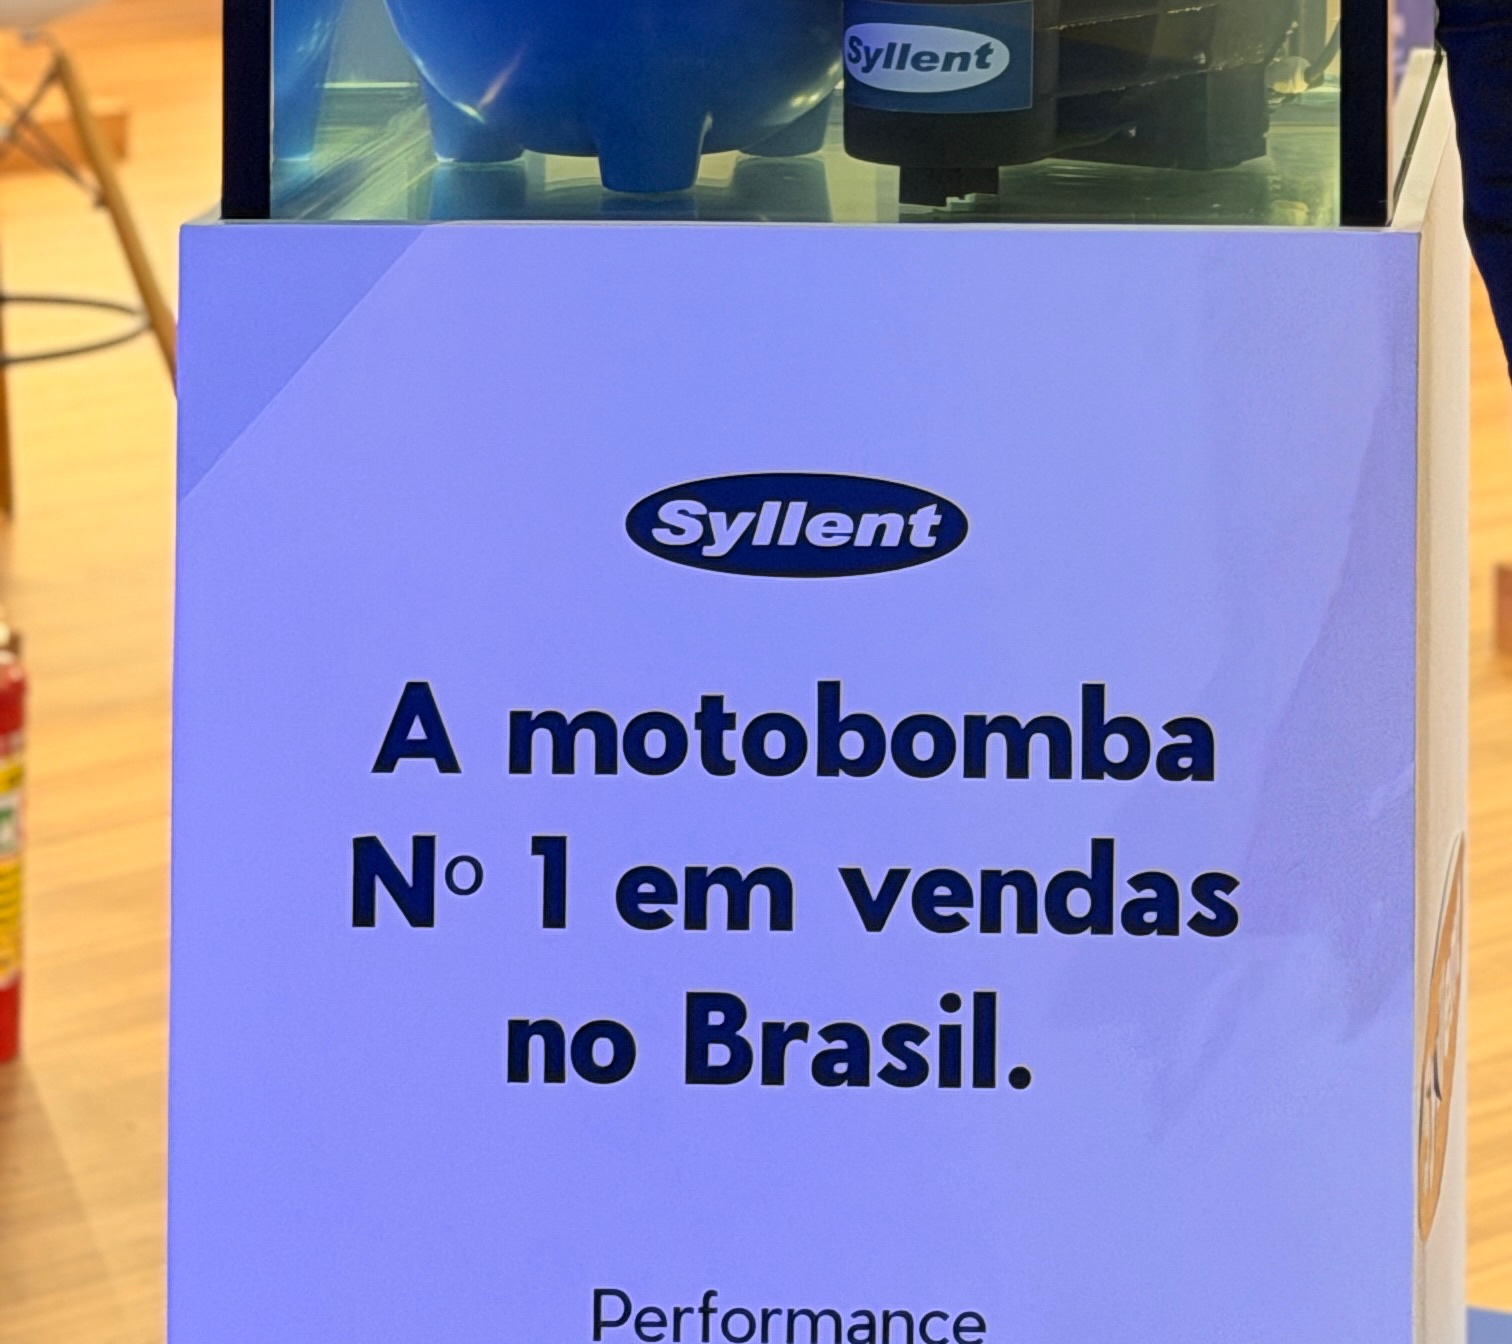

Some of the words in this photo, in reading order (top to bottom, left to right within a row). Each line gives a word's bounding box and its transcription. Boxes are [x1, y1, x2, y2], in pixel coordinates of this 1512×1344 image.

[847, 35, 995, 74] Syllent
[651, 499, 942, 557] Syllent
[371, 681, 462, 774] A
[508, 680, 1215, 782] motobomba
[531, 835, 567, 929] 1
[615, 865, 793, 932] em
[838, 837, 1240, 938] vendas
[506, 1019, 637, 1085] no
[684, 991, 1032, 1090] Brasil.
[592, 1288, 987, 1344] Performance
